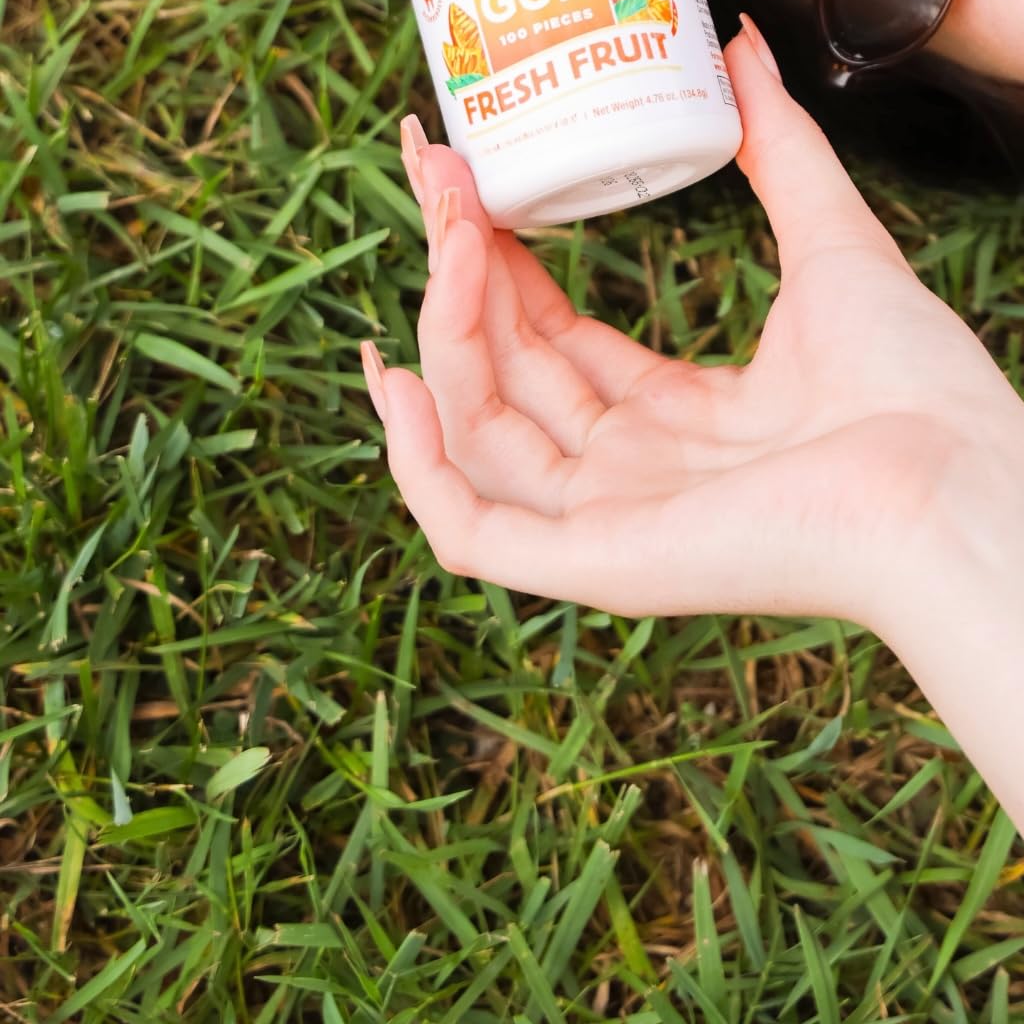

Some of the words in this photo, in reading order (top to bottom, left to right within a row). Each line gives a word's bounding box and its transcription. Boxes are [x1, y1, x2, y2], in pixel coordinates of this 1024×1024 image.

[499, 27, 528, 47] 100
[532, 7, 594, 35] PIECES
[463, 67, 559, 125] FRESH
[568, 32, 668, 81] FRUIT
[611, 98, 645, 112] Weight
